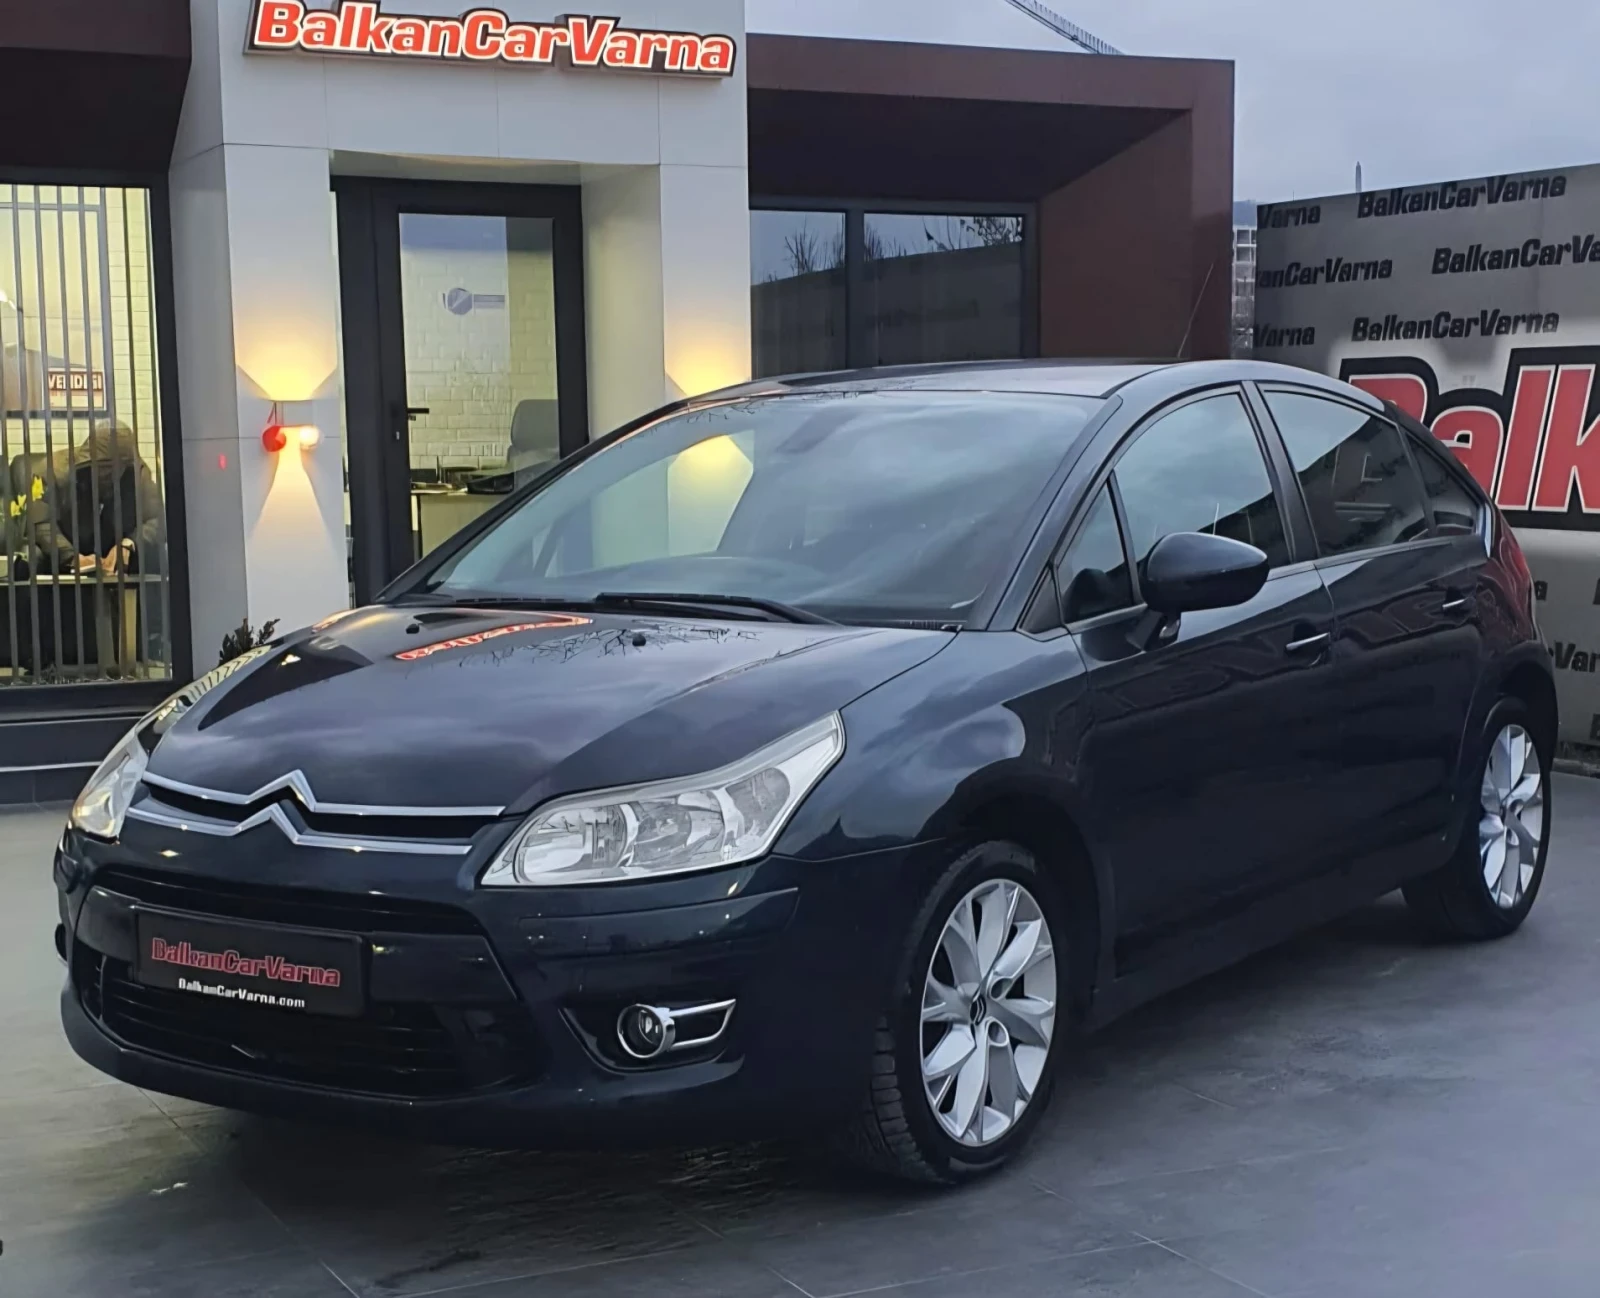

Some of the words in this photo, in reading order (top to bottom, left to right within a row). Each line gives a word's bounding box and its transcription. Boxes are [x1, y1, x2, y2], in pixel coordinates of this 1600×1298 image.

[253, 0, 736, 73] BalkanCarVarna
[1357, 175, 1567, 218] BalkanCarVarna
[1256, 257, 1393, 288] anCarVarna
[1351, 309, 1560, 342] BalkanCarVarna
[151, 937, 340, 987] BalkanCarVarna
[178, 977, 306, 1008] BalkanCarVarna.com
